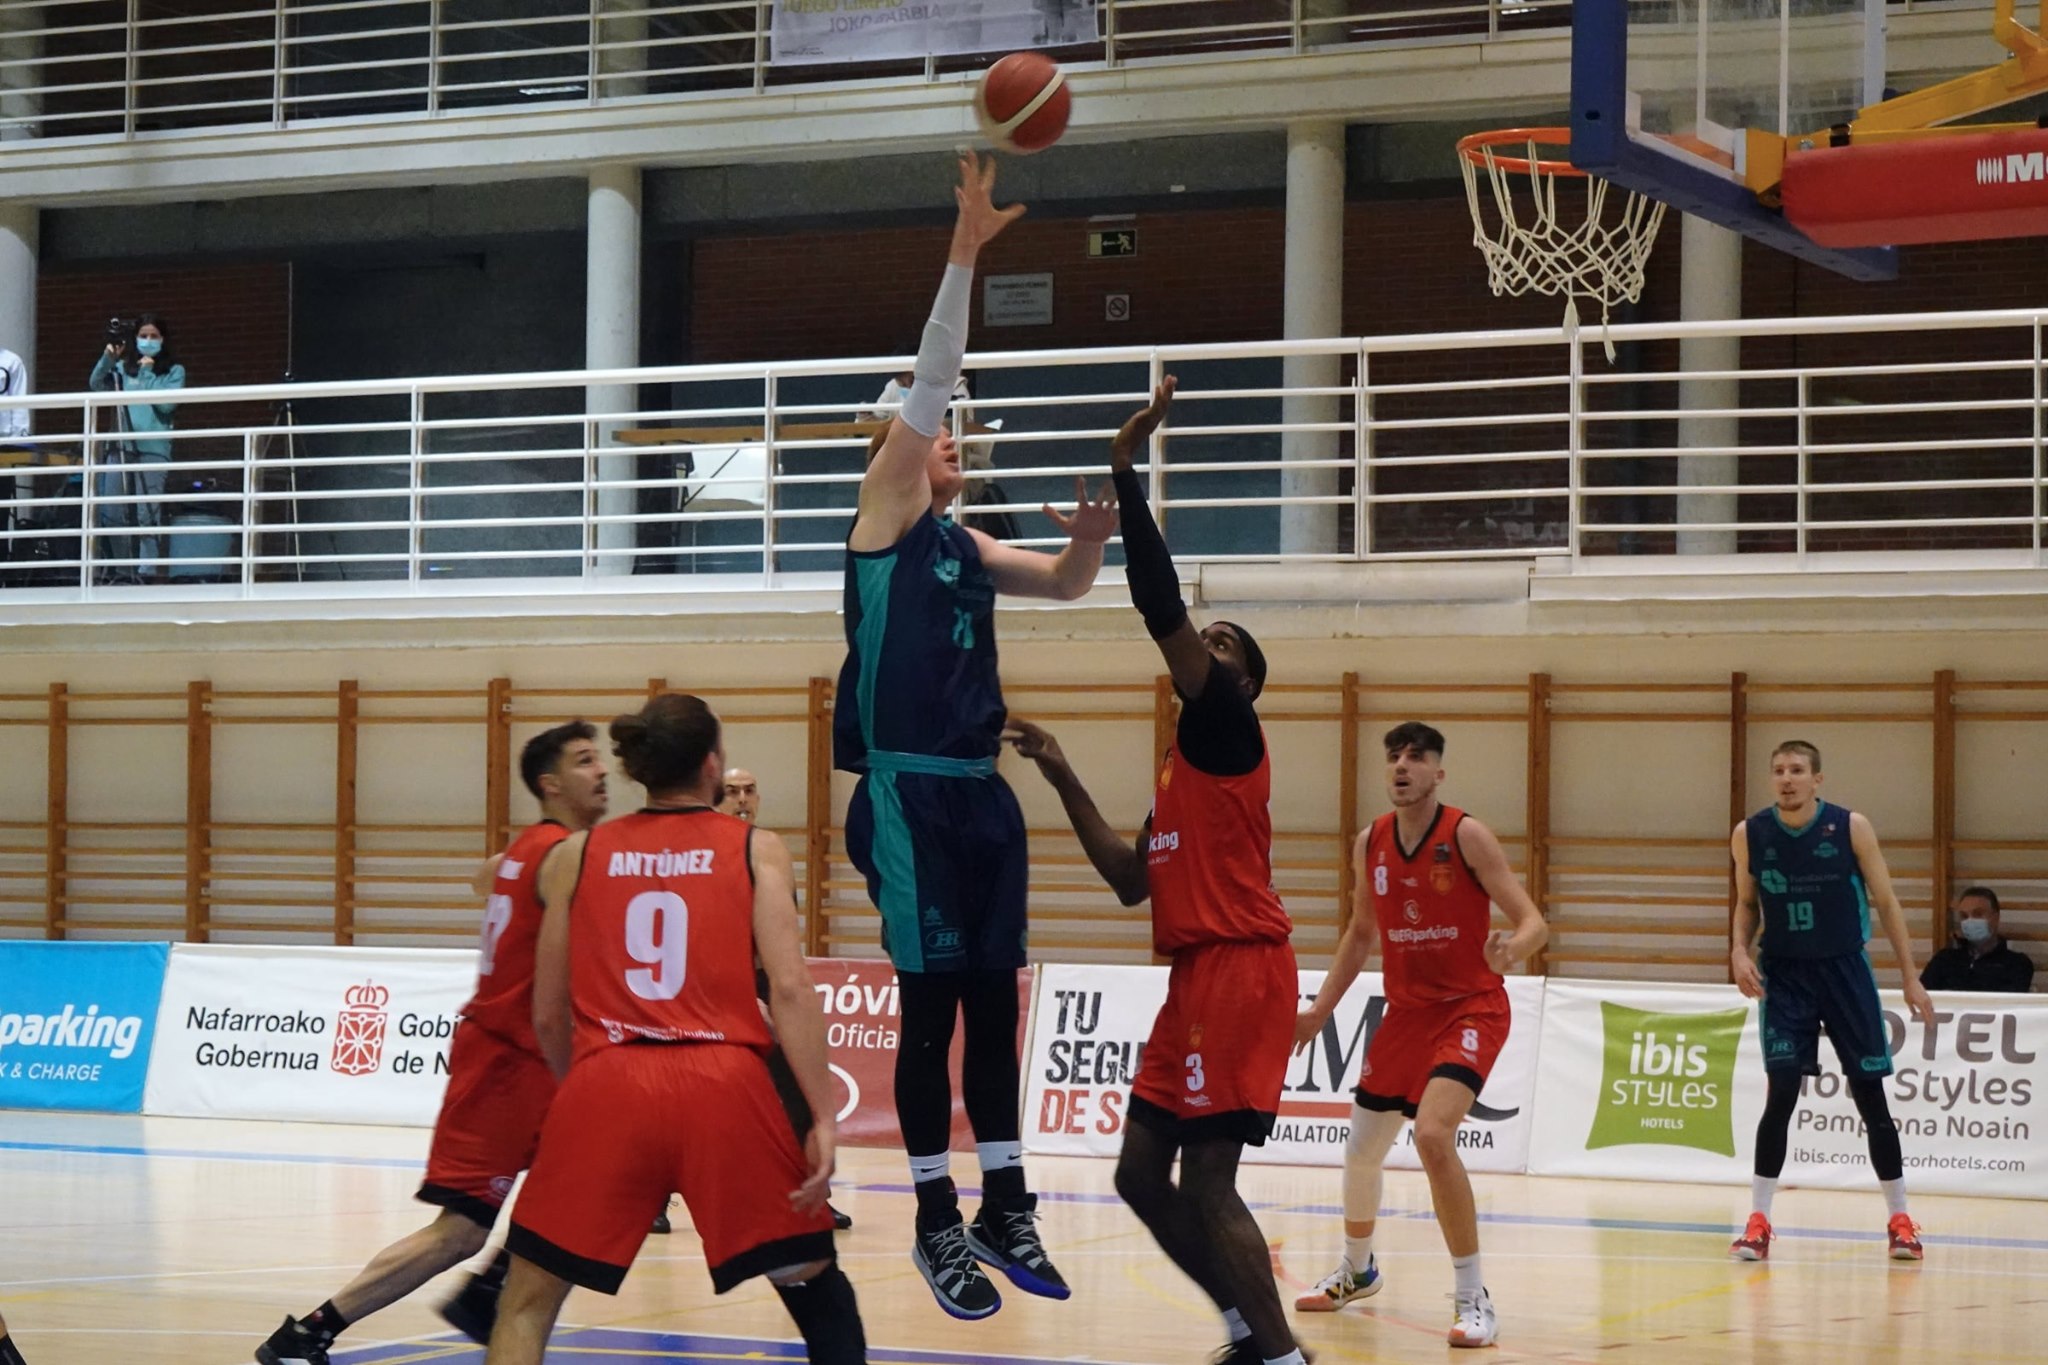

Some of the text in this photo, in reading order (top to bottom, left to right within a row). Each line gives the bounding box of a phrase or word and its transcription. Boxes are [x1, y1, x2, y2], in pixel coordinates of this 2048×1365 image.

[2005, 151, 2048, 184] M
[607, 848, 716, 878] ANTÚNEZ
[1374, 865, 1389, 896] 8
[1786, 901, 1815, 932] 19
[624, 890, 689, 1001] 9
[185, 1005, 326, 1034] Nafarroako
[398, 1012, 459, 1040] Gobi
[1054, 989, 1103, 1036] TU
[826, 1022, 898, 1050] Oficia
[1461, 1027, 1480, 1053] 8
[1882, 1009, 2037, 1065] OTEL
[195, 1041, 320, 1071] Gobernua
[392, 1050, 424, 1075] de
[1044, 1038, 1148, 1086] SEGU
[1629, 1031, 1708, 1078] ibis
[10, 1062, 23, 1079] &
[28, 1062, 103, 1082] CHARGE
[1185, 1052, 1206, 1093] 3
[1893, 1067, 2033, 1112] Styles
[1038, 1088, 1126, 1136] DE S
[1640, 1117, 1685, 1130] HOTELS
[1269, 1124, 1351, 1144] UALATOR
[1946, 1115, 2030, 1141] Noain
[1793, 1147, 2026, 1173] ibis.com corhotels.com
